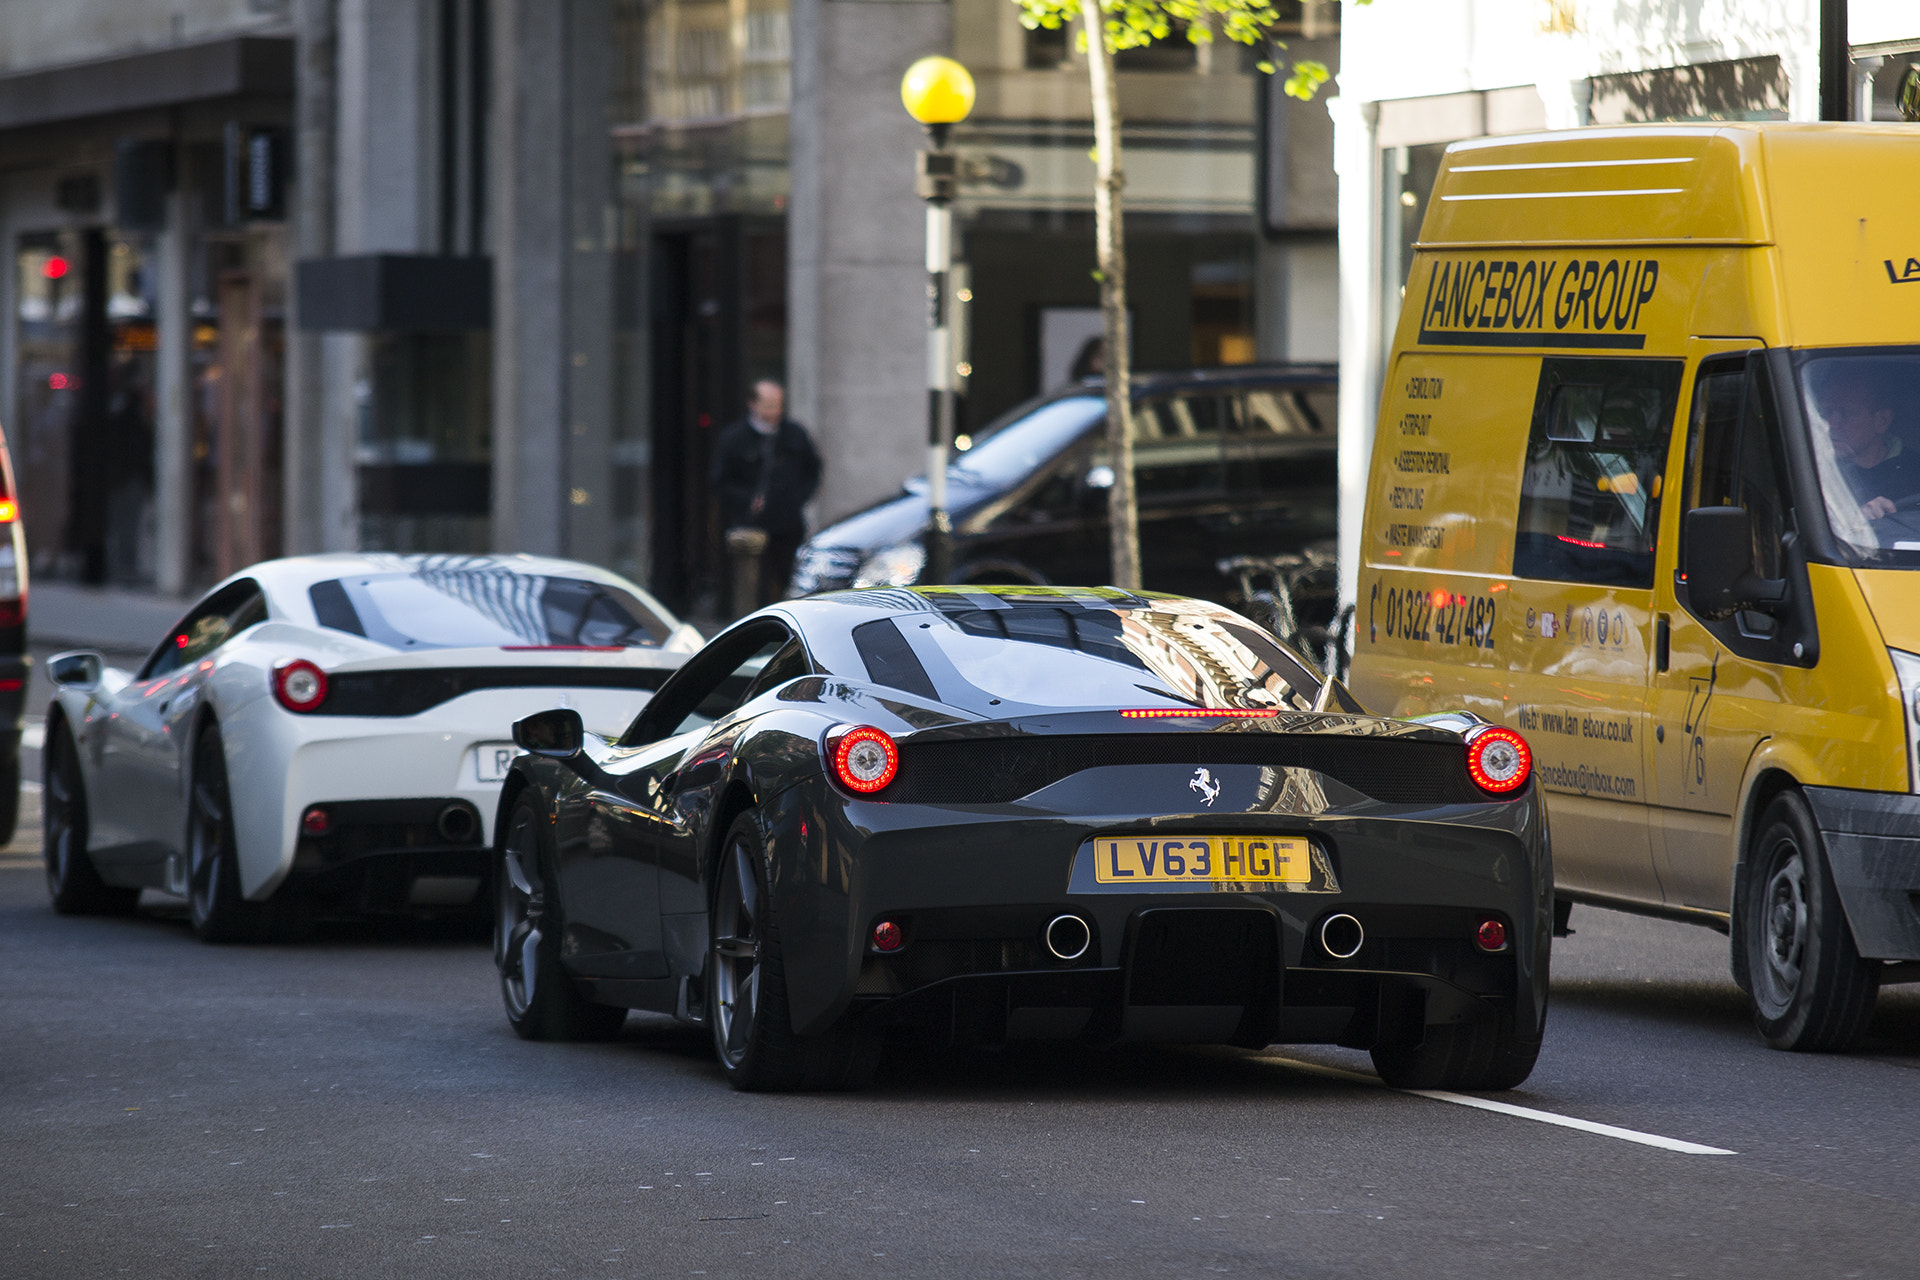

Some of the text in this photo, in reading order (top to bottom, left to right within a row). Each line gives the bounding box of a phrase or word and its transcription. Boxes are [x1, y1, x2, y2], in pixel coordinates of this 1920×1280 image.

[1417, 259, 1659, 346] LANCEBOX GROUP
[1389, 524, 1407, 547] WASTE
[1386, 587, 1432, 642] 01322
[1434, 592, 1495, 649] 427482
[1110, 842, 1294, 876] LV63 HGF
